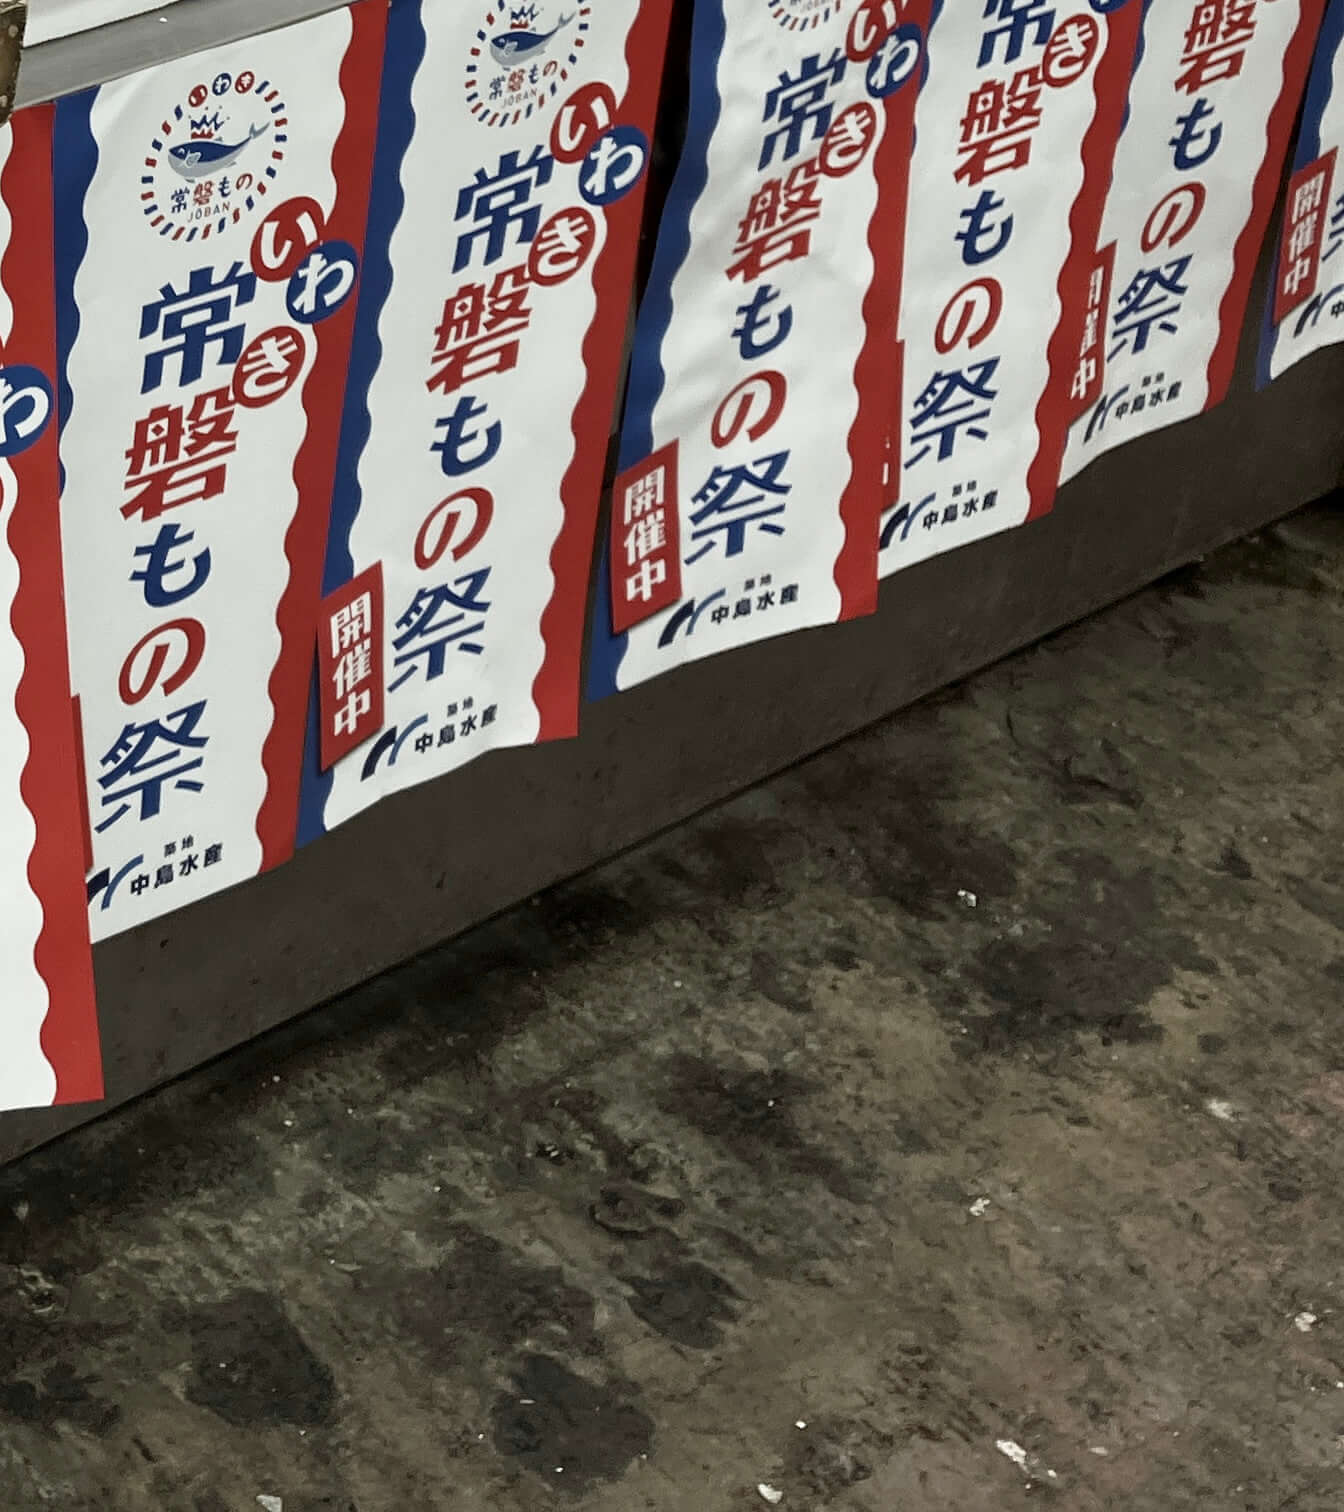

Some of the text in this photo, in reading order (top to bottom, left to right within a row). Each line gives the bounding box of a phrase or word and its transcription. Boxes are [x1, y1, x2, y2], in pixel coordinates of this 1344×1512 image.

[171, 173, 253, 213] 常磐もの
[684, 49, 847, 565] 常磐もの祭
[388, 146, 554, 691] 常磐もの祭
[95, 257, 255, 833] 常磐もの祭
[623, 470, 667, 606] 開催中
[332, 589, 373, 735] 開催中
[130, 842, 223, 894] 中島水産
